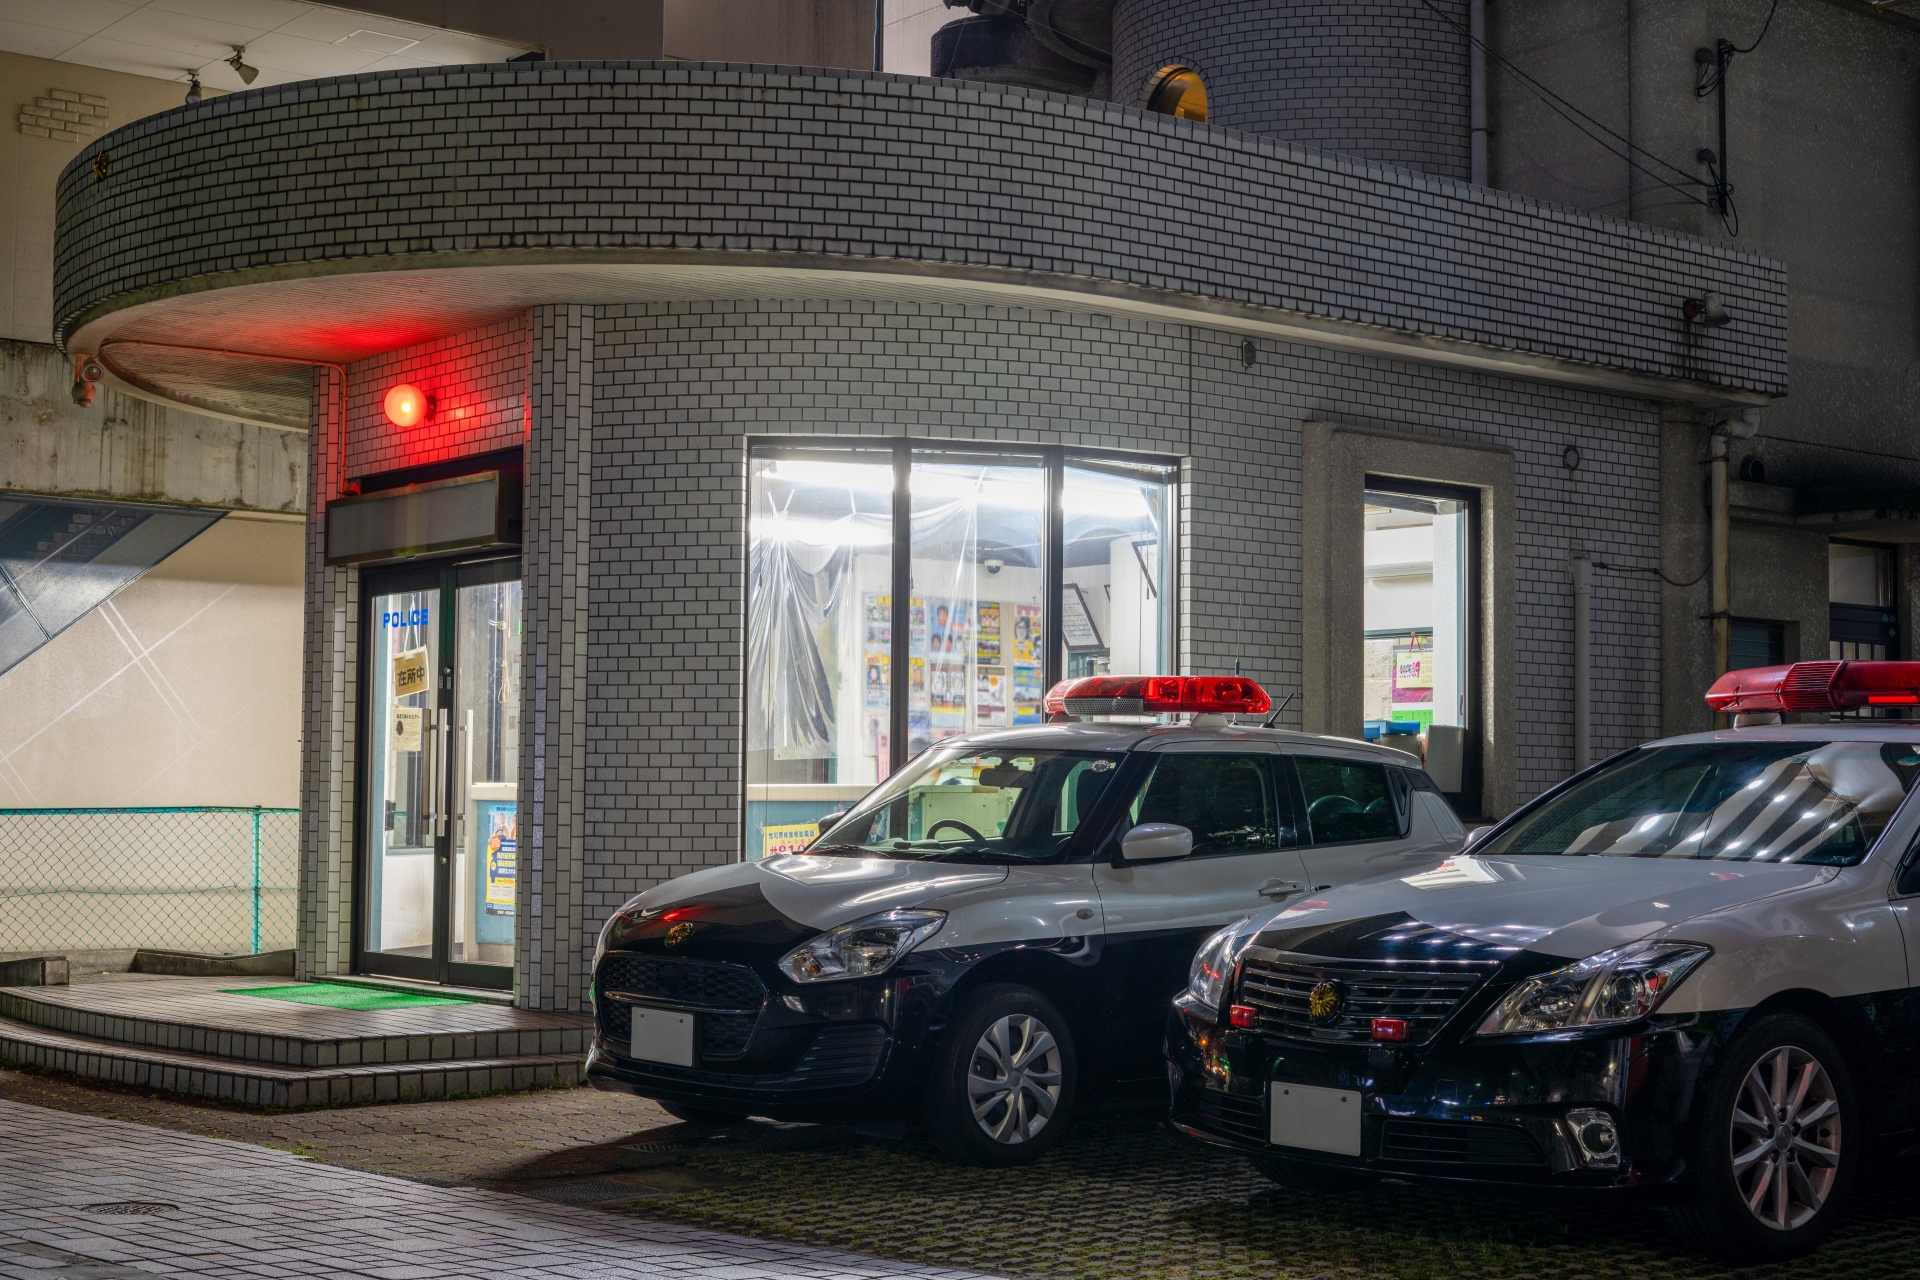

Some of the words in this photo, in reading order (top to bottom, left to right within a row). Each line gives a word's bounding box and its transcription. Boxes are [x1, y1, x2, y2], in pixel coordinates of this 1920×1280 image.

[383, 608, 429, 628] POLICE
[397, 667, 425, 687] 在所中
[768, 830, 815, 839] 性犯罪被害相談電話
